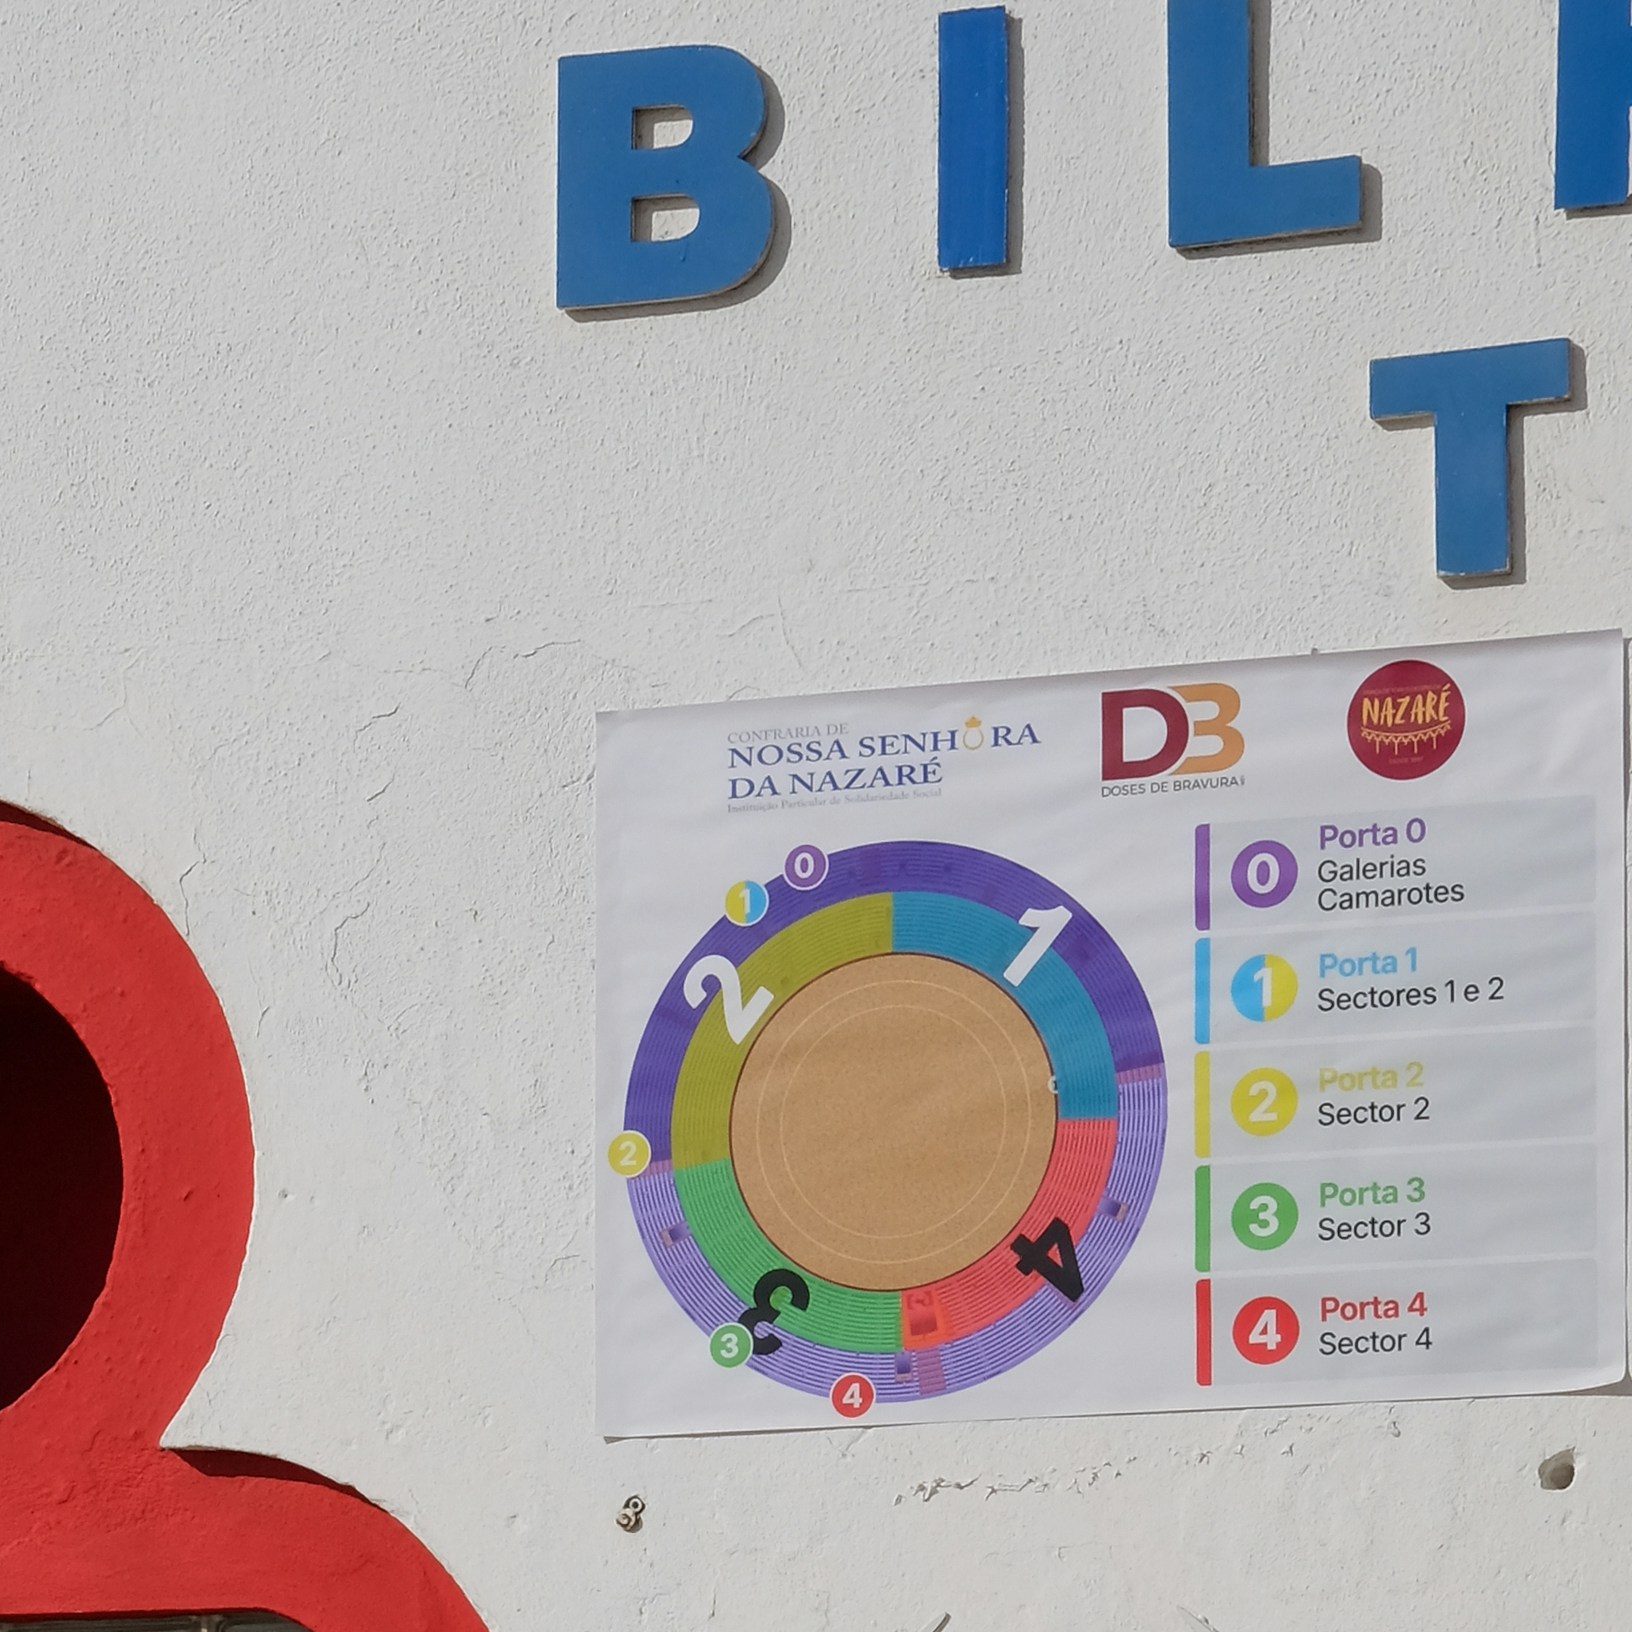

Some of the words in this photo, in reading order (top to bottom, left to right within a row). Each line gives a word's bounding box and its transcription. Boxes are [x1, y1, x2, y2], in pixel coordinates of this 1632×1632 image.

[1362, 683, 1451, 728] NAZARÉ
[727, 724, 821, 745] CONFRARIA
[826, 722, 850, 737] DE
[728, 738, 850, 769] NOSSA
[728, 775, 780, 801] DA
[790, 758, 944, 797] NAZARÉ
[1102, 782, 1145, 798] DOSES
[1150, 781, 1167, 795] DE
[1172, 776, 1238, 793] BRAVURA
[1319, 823, 1399, 850] Porta
[1405, 817, 1427, 844] 0
[793, 851, 815, 879] 0
[1247, 852, 1281, 895] 0
[1318, 855, 1427, 883] Galerias
[739, 888, 752, 915] 1
[1318, 882, 1465, 911] Camarotes
[1003, 904, 1073, 987] 1
[1319, 951, 1398, 978] Porta
[1405, 947, 1418, 973] 1
[683, 954, 775, 1045] 2
[1253, 966, 1273, 1008] 1
[1318, 984, 1437, 1012] Sectores
[1445, 979, 1456, 1003] 1
[1464, 984, 1480, 1002] e
[1488, 976, 1505, 1000] 2
[1319, 1066, 1399, 1093] Porta
[1406, 1061, 1425, 1088] 2
[1248, 1080, 1278, 1122] 2
[1318, 1101, 1406, 1126] Sector
[1414, 1096, 1431, 1121] 2
[1319, 1180, 1399, 1208] Porta
[1406, 1176, 1426, 1203] 3
[1248, 1195, 1280, 1238] 3
[1318, 1217, 1407, 1241] Sector
[1414, 1212, 1431, 1236] 3
[1009, 1216, 1085, 1303] 4
[737, 1268, 811, 1356] 3
[1321, 1295, 1400, 1322] Porta
[1407, 1291, 1428, 1317] 4
[1248, 1309, 1282, 1351] 4
[1319, 1331, 1407, 1356] Sector
[1415, 1326, 1433, 1351] 4
